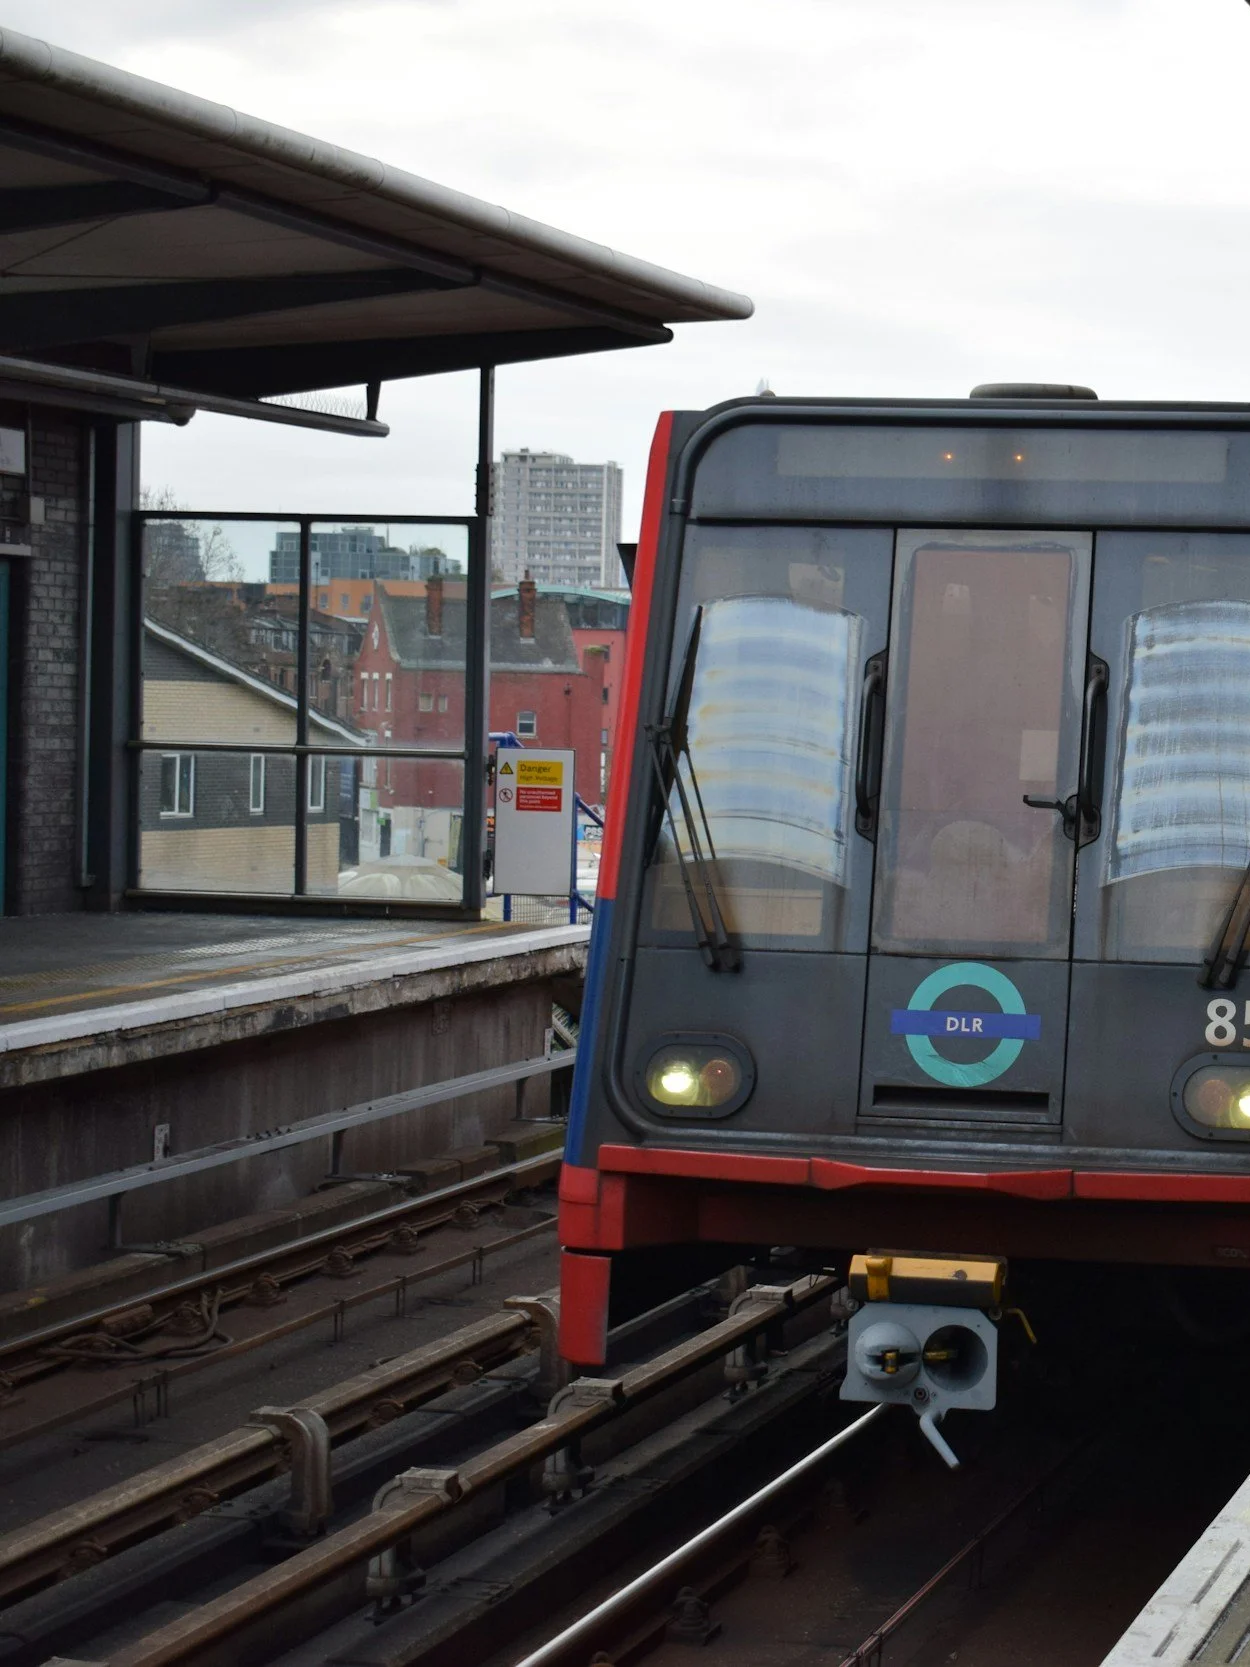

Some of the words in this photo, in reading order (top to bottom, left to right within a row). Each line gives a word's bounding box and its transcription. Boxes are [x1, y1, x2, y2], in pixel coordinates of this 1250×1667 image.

[520, 763, 552, 774] Danger
[519, 774, 536, 782] High
[946, 1016, 983, 1033] DLR
